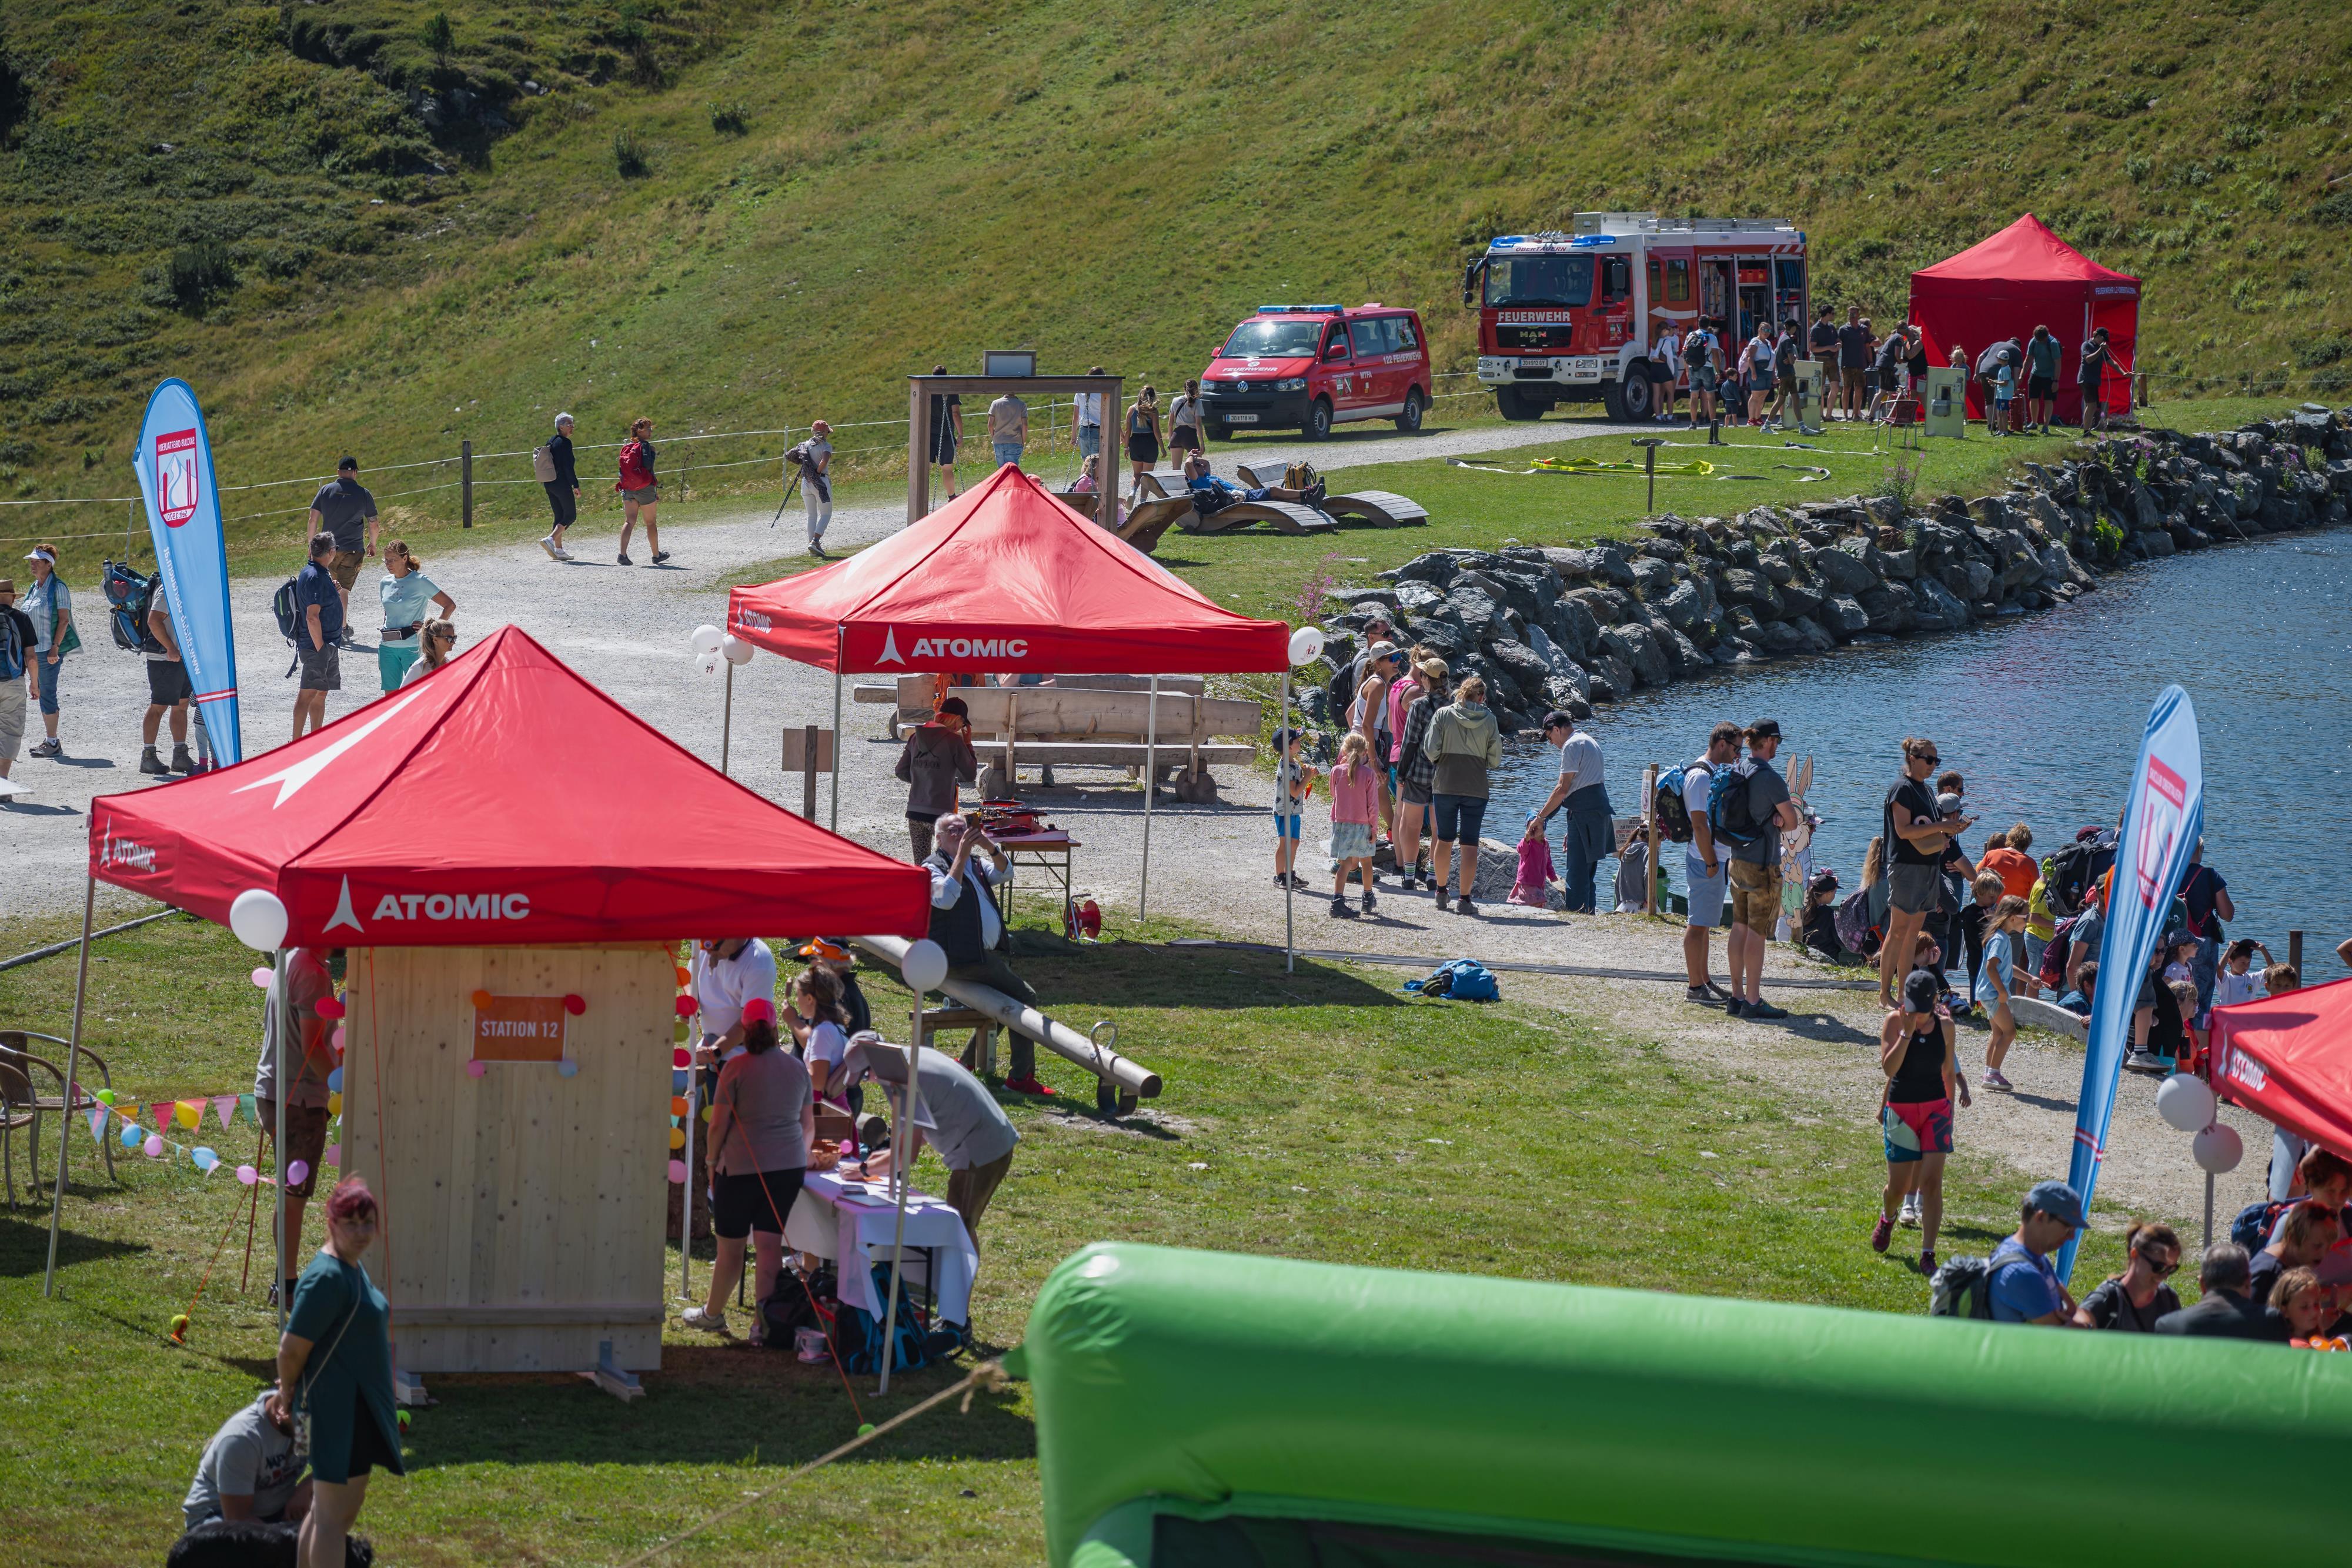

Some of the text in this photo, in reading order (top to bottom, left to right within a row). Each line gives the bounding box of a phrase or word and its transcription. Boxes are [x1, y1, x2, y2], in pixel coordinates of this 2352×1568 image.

[1498, 312, 1570, 322] FEUERWEHR
[1383, 351, 1422, 364] 122 FEUERWEHR
[1359, 370, 1372, 379] MTFA
[744, 609, 772, 634] ATOMIC
[911, 638, 1028, 657] ATOMIC
[113, 837, 156, 874] ATOMIC
[372, 893, 530, 920] ATOMIC
[482, 1021, 558, 1038] STATION 12
[2228, 1047, 2270, 1092] ATOMIC
